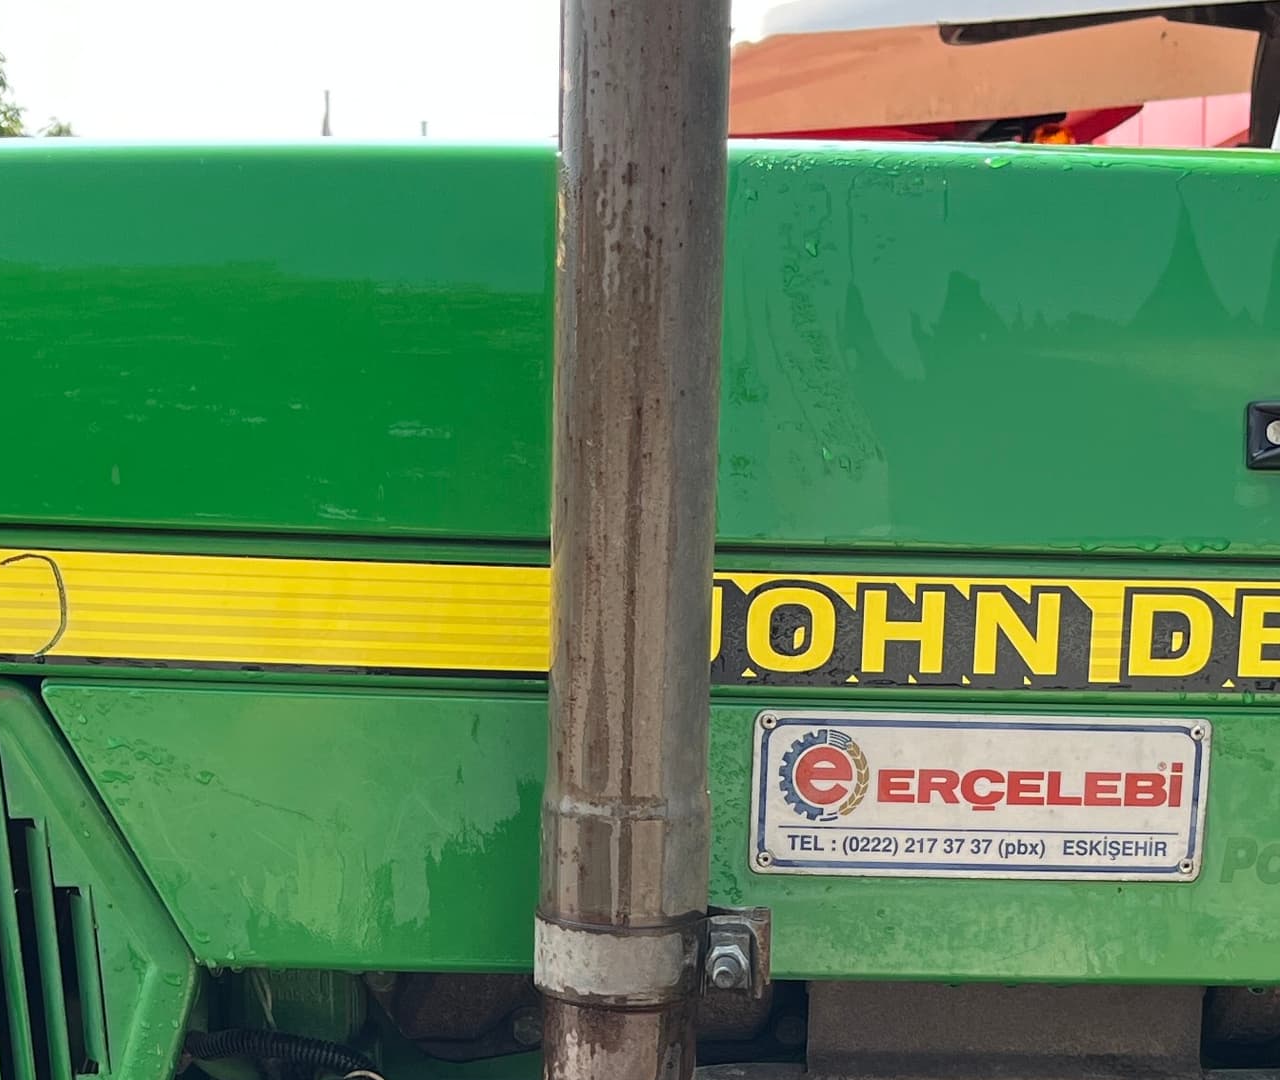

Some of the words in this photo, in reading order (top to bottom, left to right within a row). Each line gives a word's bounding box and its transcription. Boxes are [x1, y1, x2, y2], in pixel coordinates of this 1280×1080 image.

[710, 585, 1062, 676] OHN
[876, 762, 1184, 812] ERÇELEBİ
[842, 835, 900, 855] (0222)
[904, 837, 938, 854] 217
[942, 837, 966, 855] 37
[969, 838, 993, 856] 37
[998, 838, 1047, 860] (pbx)
[1062, 836, 1168, 861] ESKİŞEHİR
